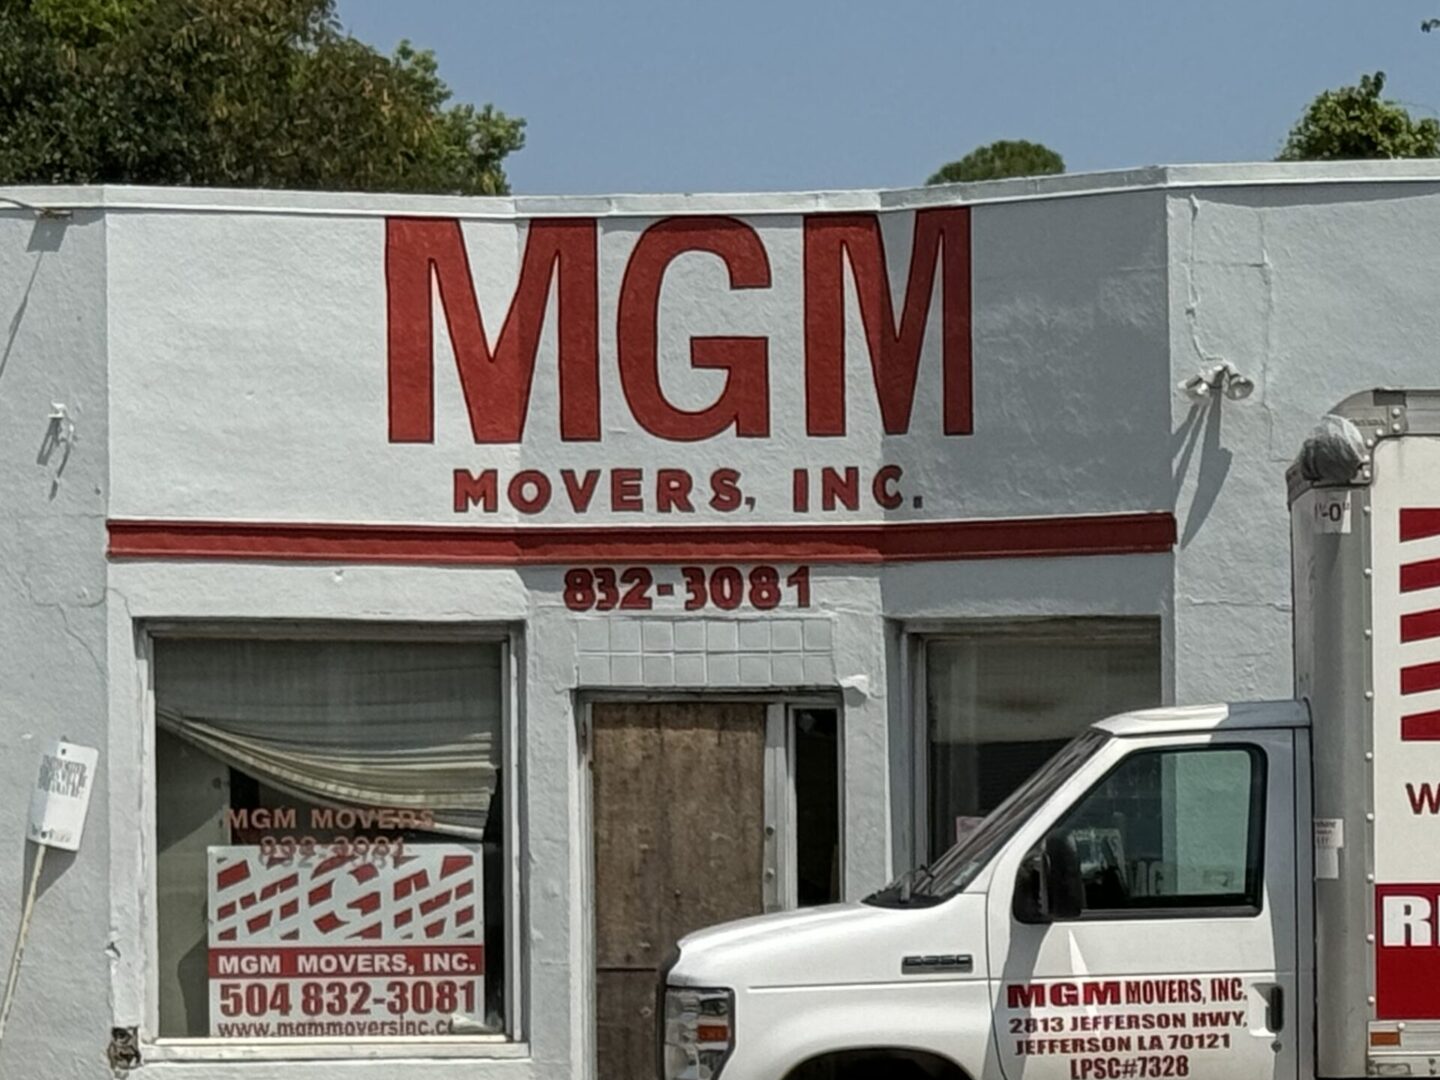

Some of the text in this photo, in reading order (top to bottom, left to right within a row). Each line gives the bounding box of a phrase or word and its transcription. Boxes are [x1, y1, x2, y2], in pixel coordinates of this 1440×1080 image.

[385, 206, 974, 444] MGM
[453, 465, 924, 514] MOVERS, INC.
[562, 565, 811, 612] 832-3081
[224, 808, 435, 830] MGM MOVERS
[218, 953, 477, 975] MGM MOVERS, INC.
[219, 980, 476, 1017] 504 832-3081
[1006, 977, 1249, 1009] MGM MOVERS, INC.
[1008, 1011, 1249, 1034] 2813 JEFFERSON HWY,
[1014, 1033, 1232, 1056] JEFFERSON LA 70121
[1069, 1055, 1190, 1080] LPSC#7328
